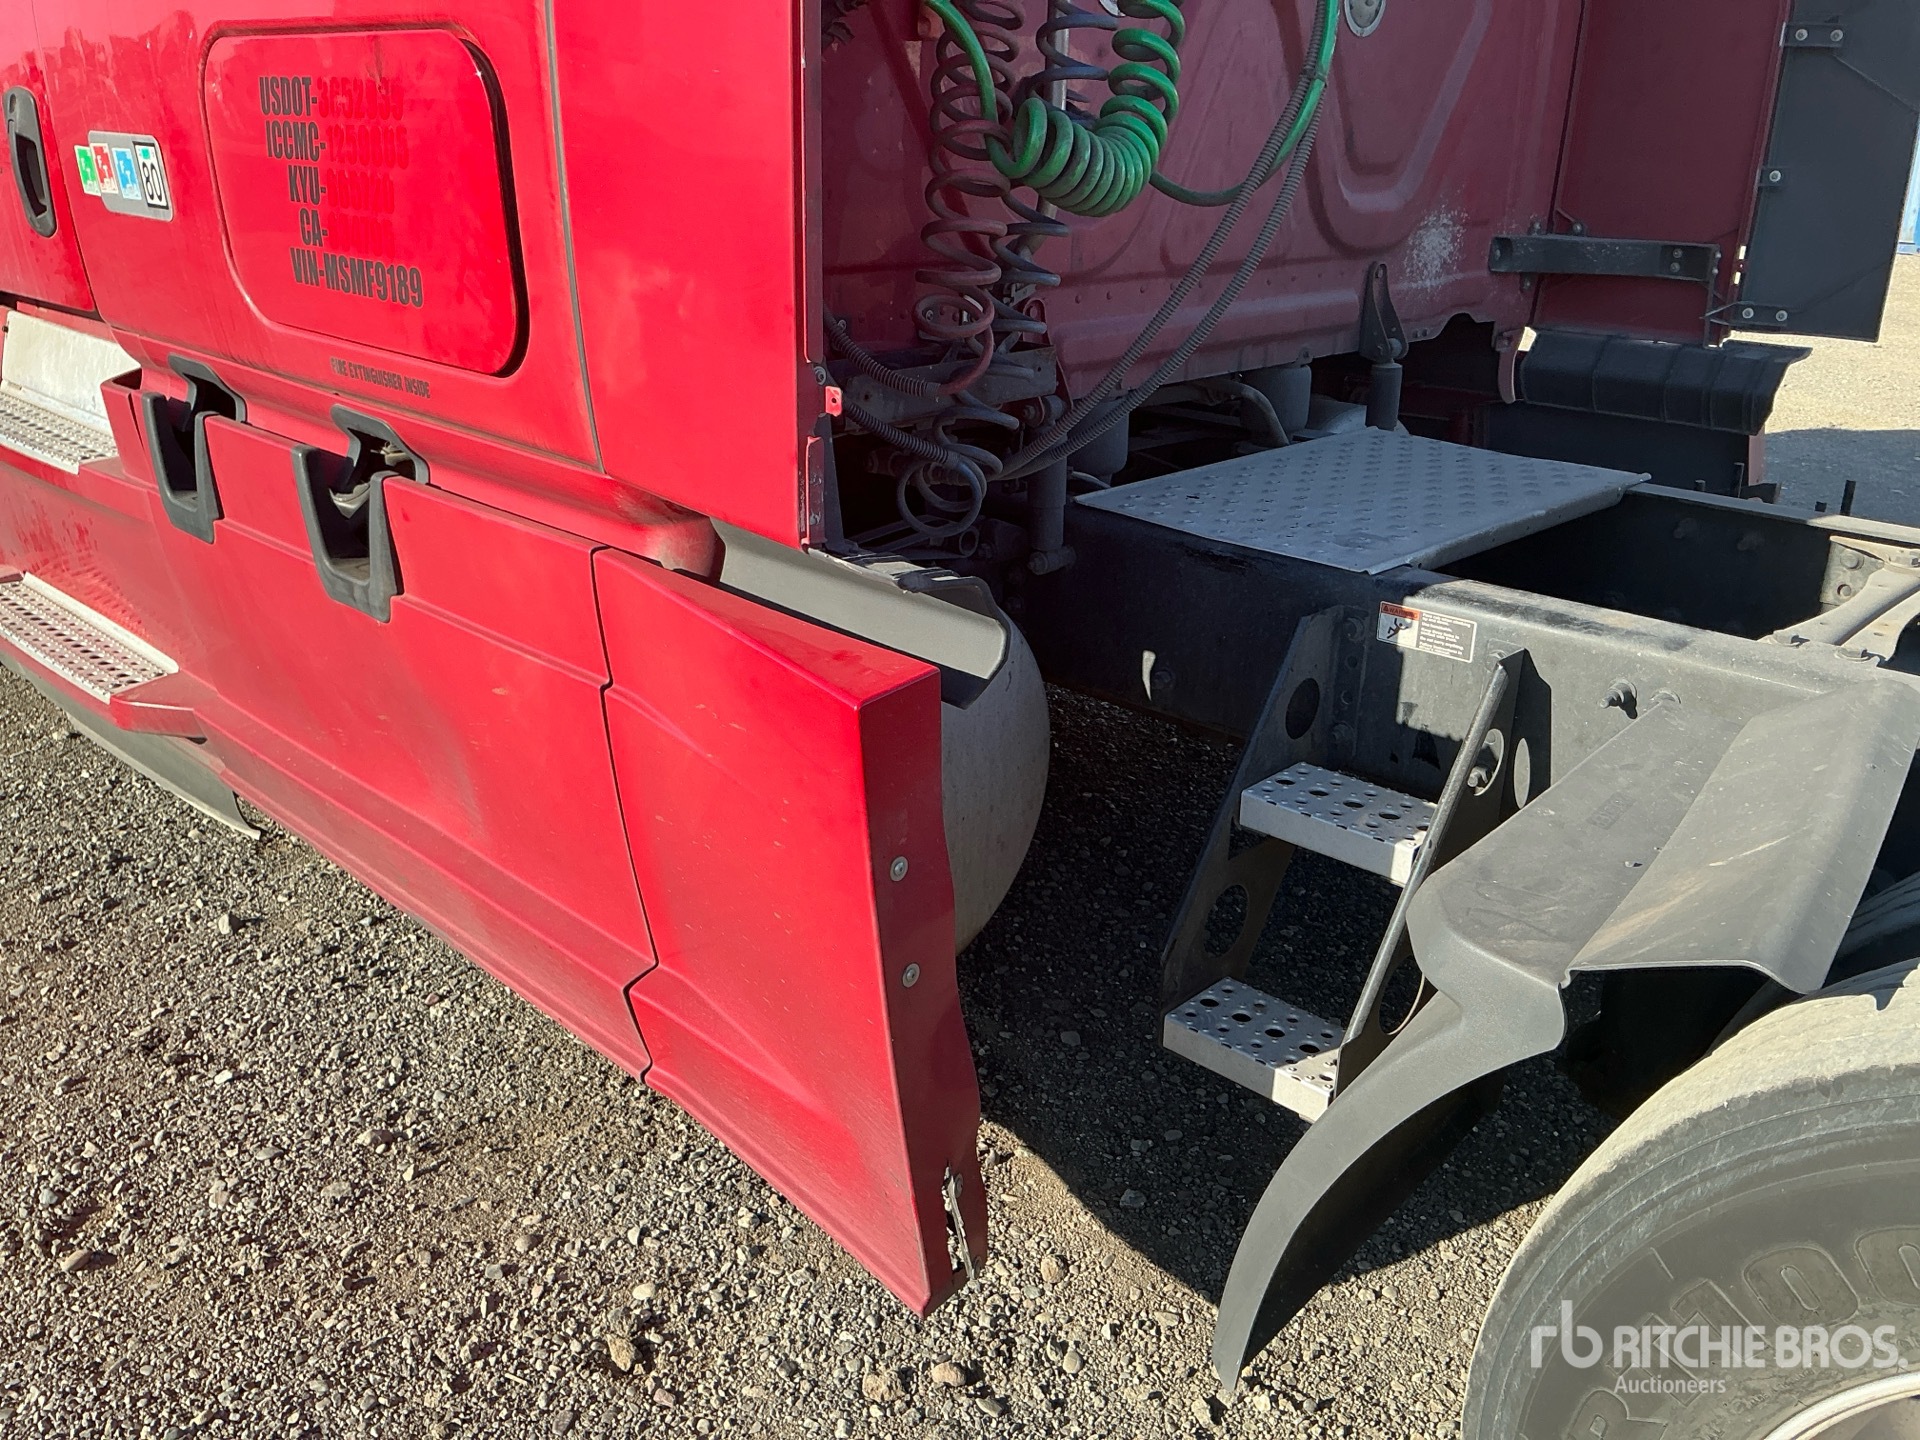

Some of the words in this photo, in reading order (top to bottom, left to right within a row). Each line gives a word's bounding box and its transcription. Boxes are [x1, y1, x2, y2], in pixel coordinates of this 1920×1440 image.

[289, 247, 424, 308] VIN-MSMF9189
[347, 361, 403, 391] EXTINGUISHER
[404, 375, 431, 399] INSIDE
